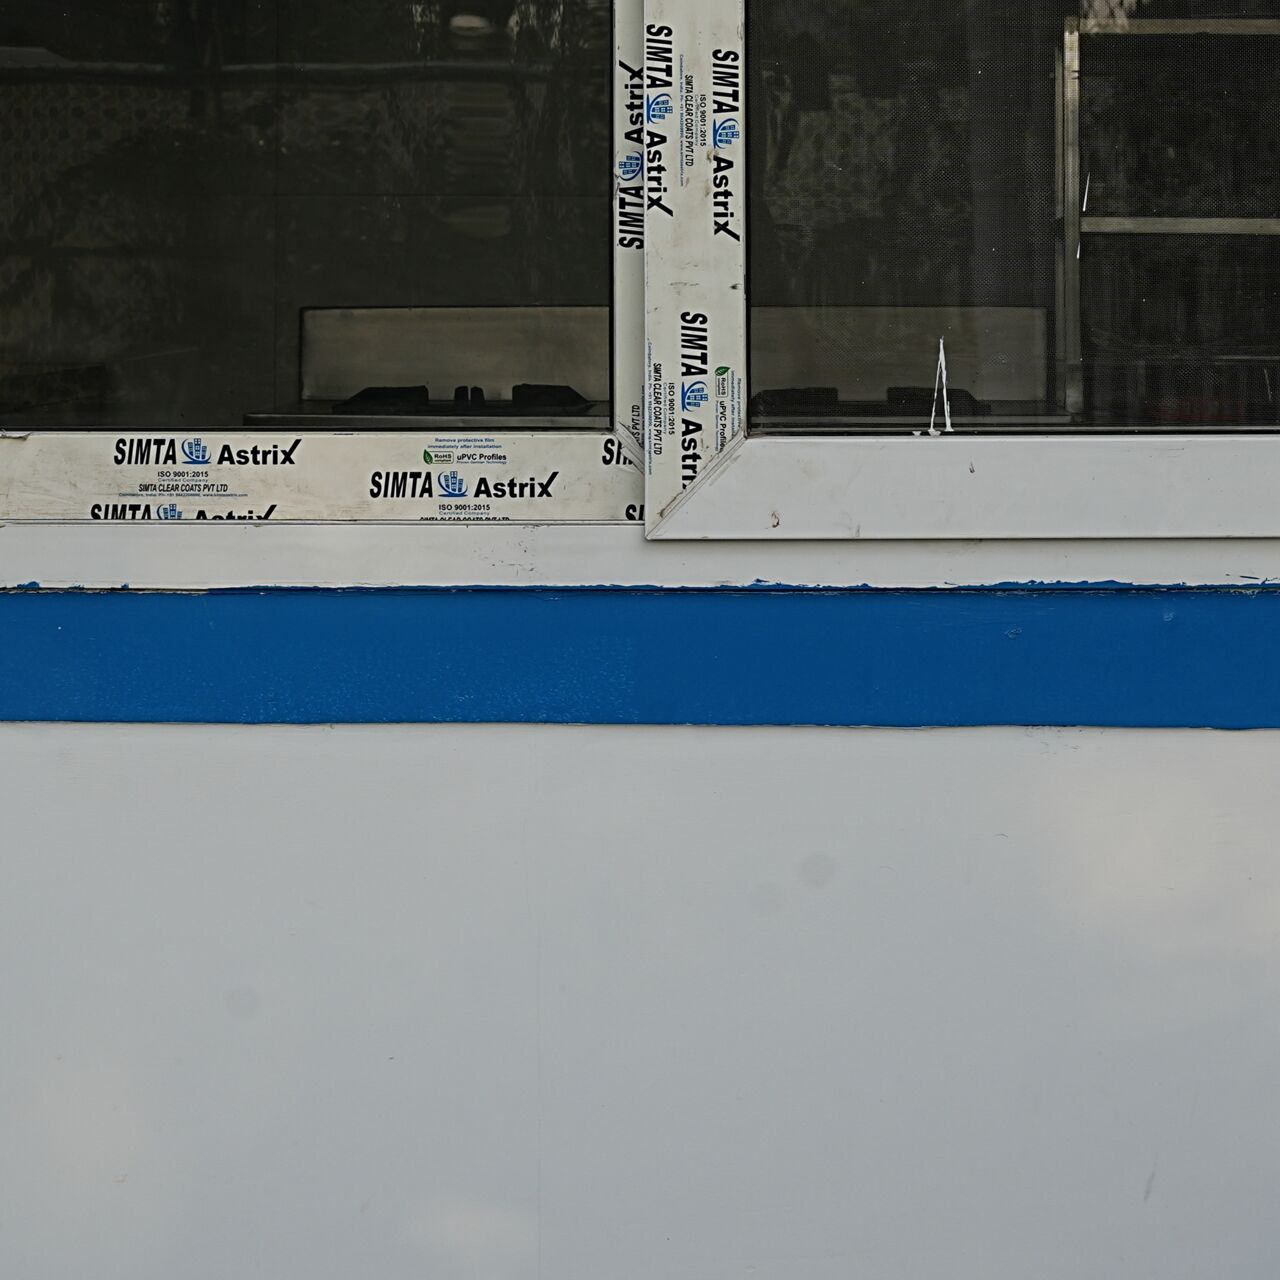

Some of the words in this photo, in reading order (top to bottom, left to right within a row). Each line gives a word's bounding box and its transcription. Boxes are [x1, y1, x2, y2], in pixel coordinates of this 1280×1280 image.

[646, 24, 672, 88] SIMTA
[712, 49, 739, 113] SIMTA
[619, 186, 644, 249] SIMTA
[681, 312, 707, 376] SIMTA
[114, 439, 176, 465] SIMTA
[370, 472, 433, 498] SIMTA
